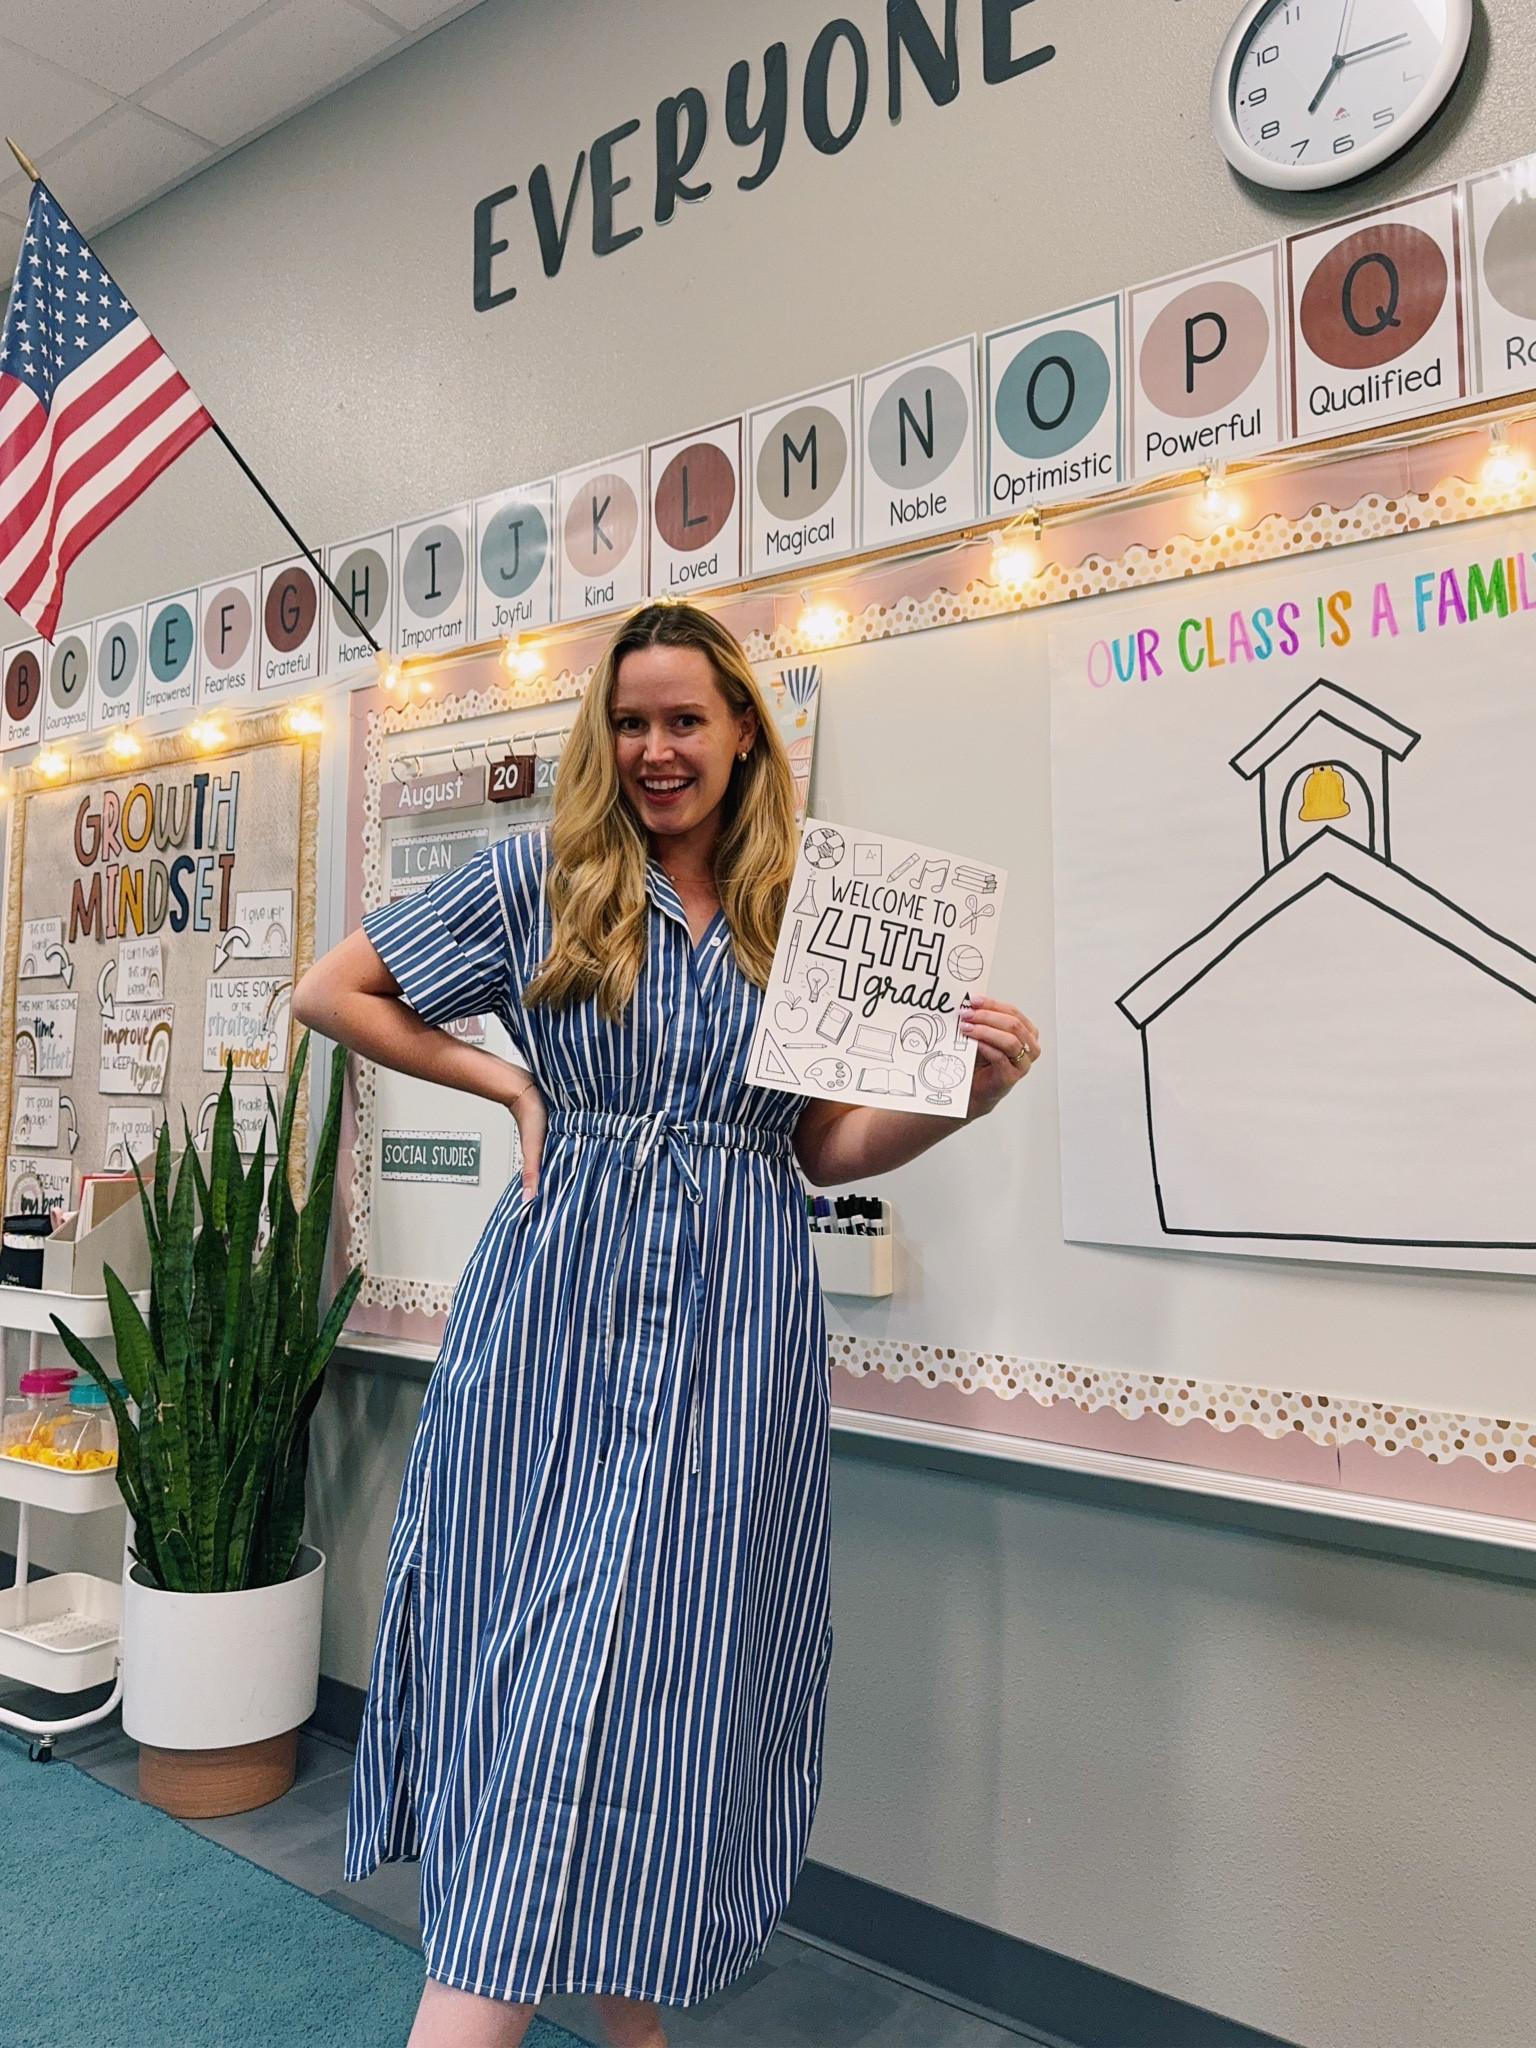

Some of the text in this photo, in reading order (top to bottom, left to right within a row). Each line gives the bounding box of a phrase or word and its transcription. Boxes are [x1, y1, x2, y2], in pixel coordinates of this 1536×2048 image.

[1286, 6, 1300, 25] 11
[1257, 45, 1279, 67] 10
[1248, 87, 1267, 107] 9
[1373, 107, 1394, 129] 5
[1261, 120, 1280, 140] 8
[1291, 139, 1310, 158] 7
[1333, 134, 1354, 154] 6
[472, 0, 1056, 312] EVERYONE
[1341, 252, 1402, 337] Q
[1184, 311, 1228, 394] P
[1026, 355, 1076, 431] O
[1308, 357, 1442, 417] Qualified
[898, 387, 934, 467] N
[1145, 408, 1262, 463] Powerful
[782, 424, 818, 498] M
[993, 452, 1113, 505] Optimistic
[682, 465, 709, 528] L
[889, 491, 947, 527] Noble
[592, 494, 614, 555] K
[765, 517, 835, 556] Magical
[424, 541, 442, 600] I
[499, 520, 525, 581] J
[669, 553, 718, 585] Loved
[279, 583, 300, 635] G
[351, 565, 370, 618] H
[584, 581, 614, 608] Kind
[220, 604, 235, 655] F
[401, 619, 463, 649] Important
[491, 599, 533, 629] Joyful
[1086, 551, 1536, 688] OUR CLASS IS A FAMIL
[111, 635, 126, 681] D
[165, 618, 178, 666] E
[338, 640, 381, 664] Hones
[17, 664, 29, 707] B
[62, 650, 77, 694] C
[204, 672, 246, 695] Fearless
[265, 652, 311, 679] Grateful
[102, 700, 130, 720] Daring
[146, 684, 191, 707] Empowered
[8, 725, 30, 742] Brave
[46, 711, 86, 730] Courageous
[398, 775, 464, 809] August
[493, 764, 519, 791] 20
[74, 771, 241, 867] GROWTH
[404, 847, 410, 874] I
[69, 853, 236, 943] MINDSET
[832, 876, 957, 928] WELCOME TO
[806, 907, 945, 1001] 4TH
[861, 975, 955, 1018] grade
[384, 1144, 477, 1167] SOCIAL STUDIES
